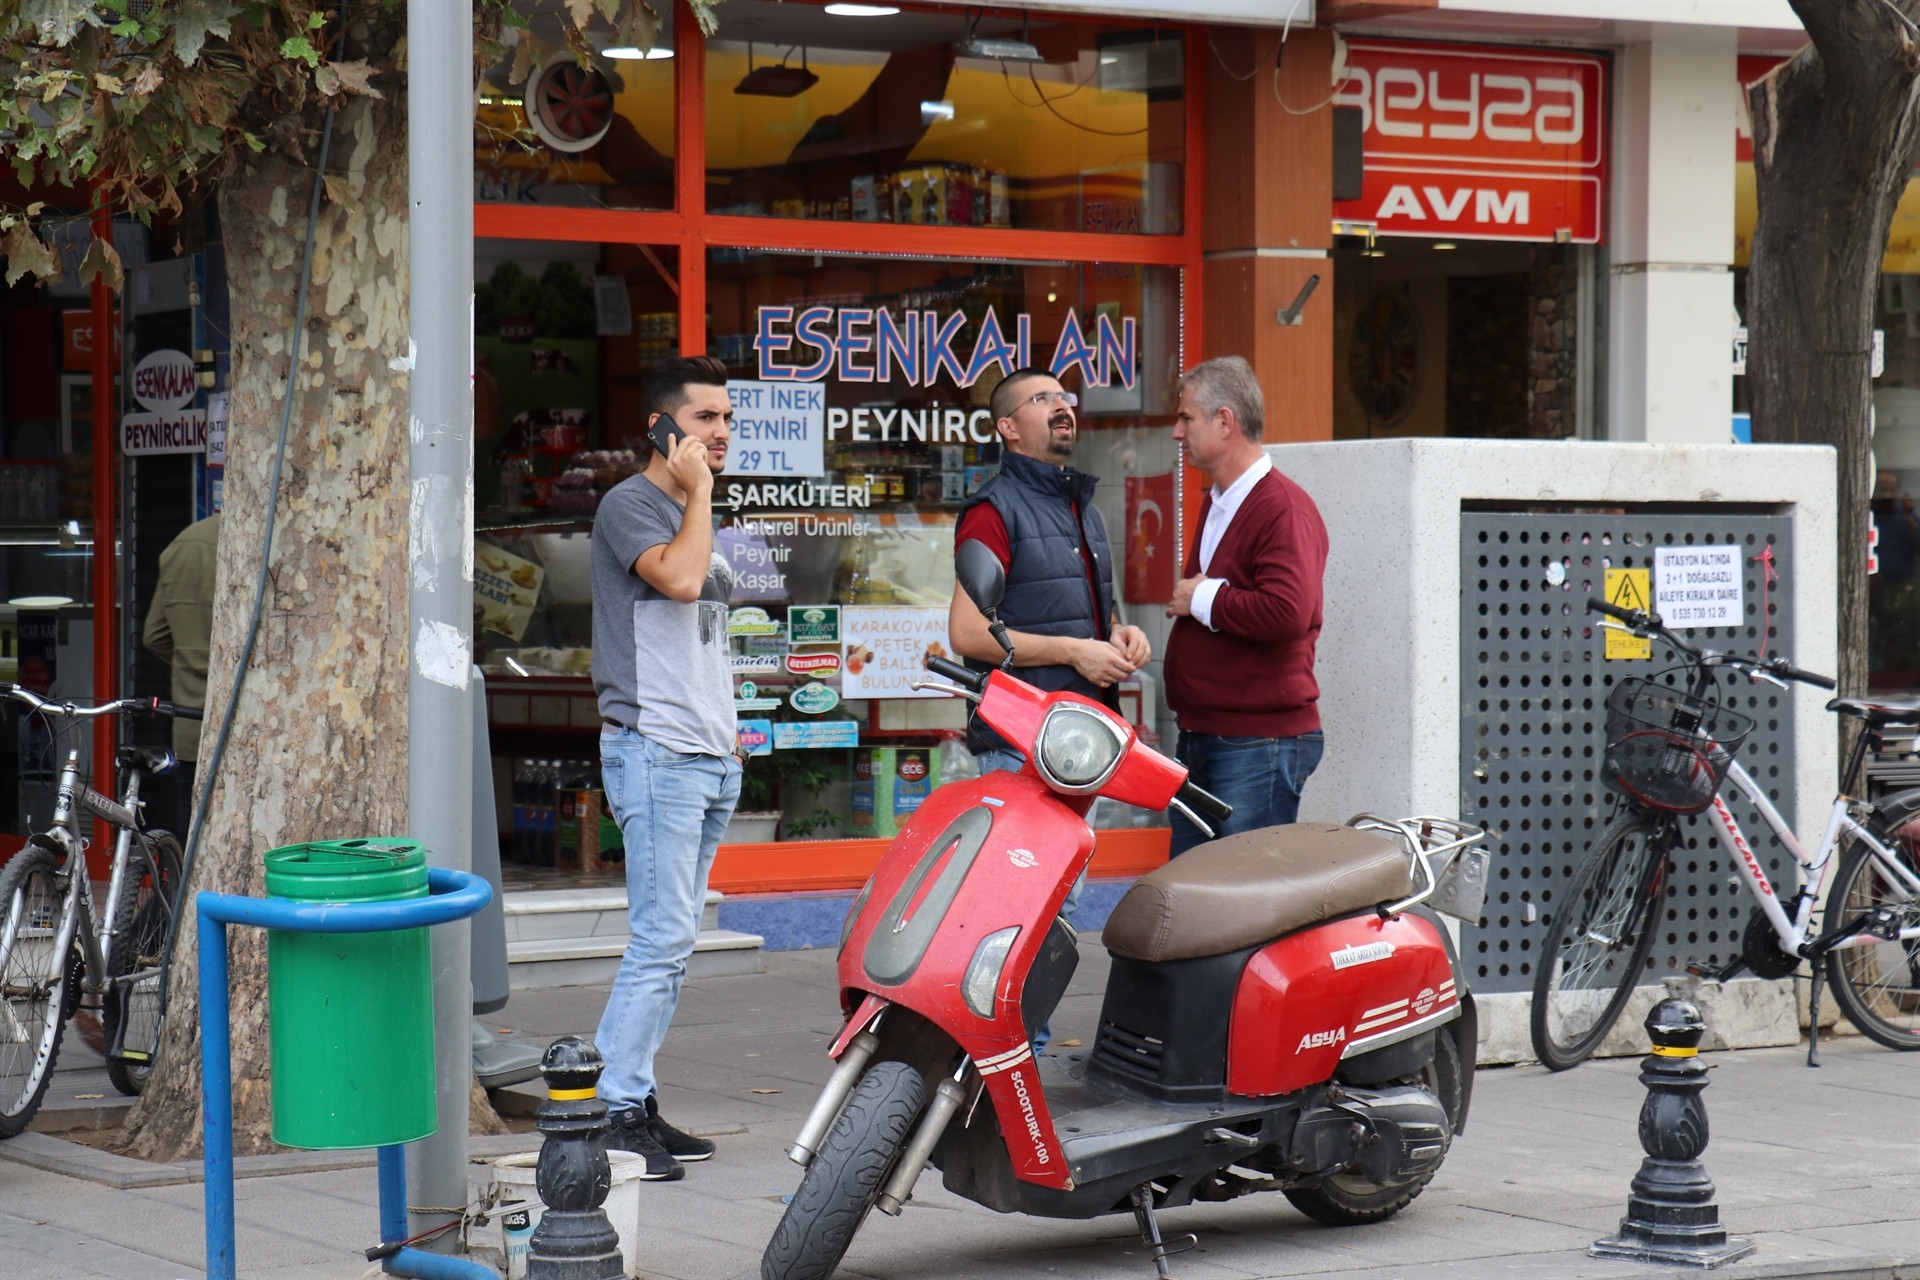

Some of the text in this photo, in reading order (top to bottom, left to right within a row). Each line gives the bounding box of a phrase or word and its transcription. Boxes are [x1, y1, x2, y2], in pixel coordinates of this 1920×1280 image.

[1376, 185, 1530, 224] AVM
[136, 362, 196, 401] ESENKALAN
[727, 385, 822, 410] ERT İNEK
[125, 415, 207, 450] PEYNİRCİLİK
[828, 400, 1002, 443] PEYNİRC
[739, 450, 793, 471] 29 TL
[727, 480, 871, 512] ŞARKÜTERİ
[805, 514, 870, 537] Ürünler
[733, 543, 791, 567] Peynir
[733, 570, 786, 593] Kaşar
[850, 620, 946, 634] KARAKOVAN
[874, 638, 922, 652] PETEK
[861, 675, 934, 689] BULUNUR
[87, 792, 113, 814] EXCEL
[1713, 797, 1772, 896] SALCANO
[1295, 1025, 1346, 1055] ASYA
[1010, 1070, 1050, 1165] SCOOTURK-100
